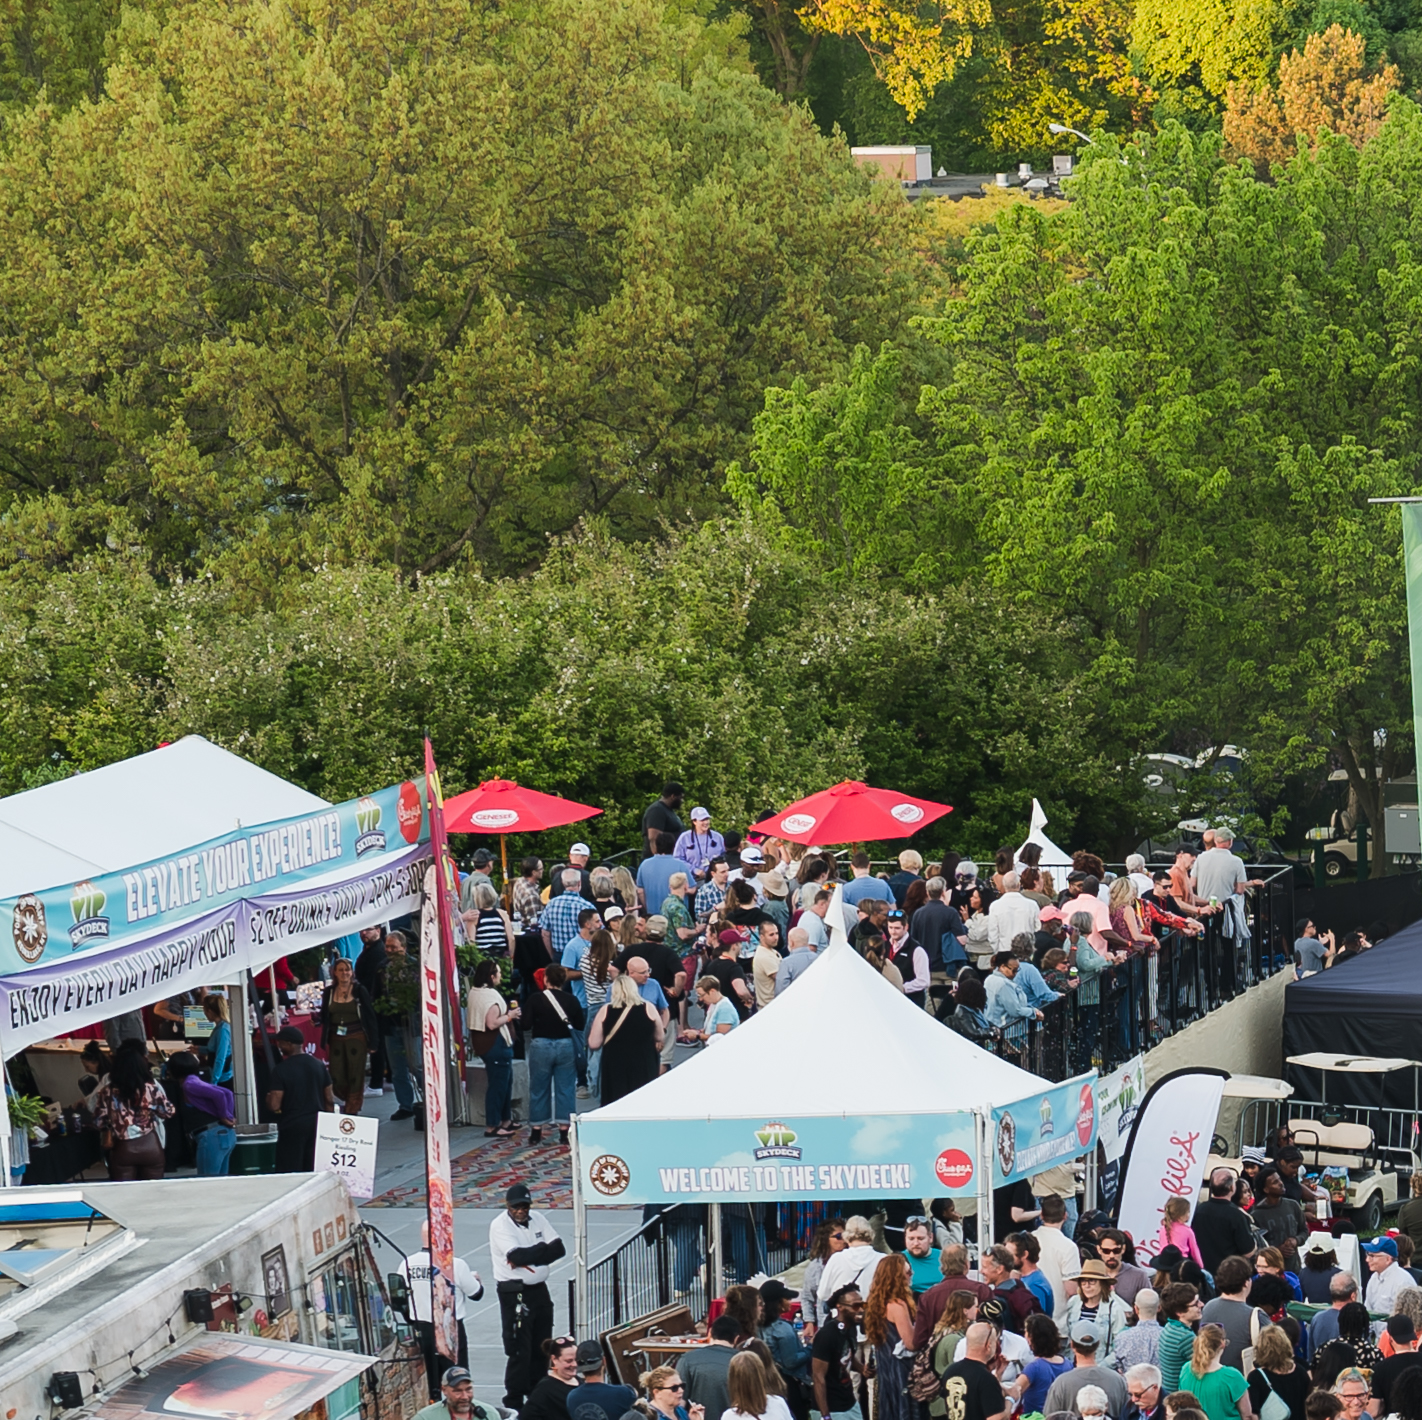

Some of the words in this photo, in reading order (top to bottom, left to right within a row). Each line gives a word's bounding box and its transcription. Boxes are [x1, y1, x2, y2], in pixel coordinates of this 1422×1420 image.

[125, 854, 202, 923] ELEVATE
[200, 843, 247, 892] YOUR
[249, 812, 343, 880] EXPERIENCE!
[287, 897, 332, 934] DRINKS
[333, 882, 366, 920] DAILY
[10, 992, 60, 1030] ENJOY
[64, 973, 114, 1015] EVERY
[117, 965, 149, 996] DAY
[150, 940, 197, 985] HAPPY
[198, 919, 237, 964] HOUR
[753, 1129, 798, 1148] VIP
[756, 1148, 800, 1159] SKYDECK
[330, 1151, 357, 1168] $12
[658, 1164, 751, 1194] WELCOME
[754, 1166, 778, 1192] TO
[780, 1165, 815, 1191] THE
[819, 1163, 911, 1190] SKYDECK!
